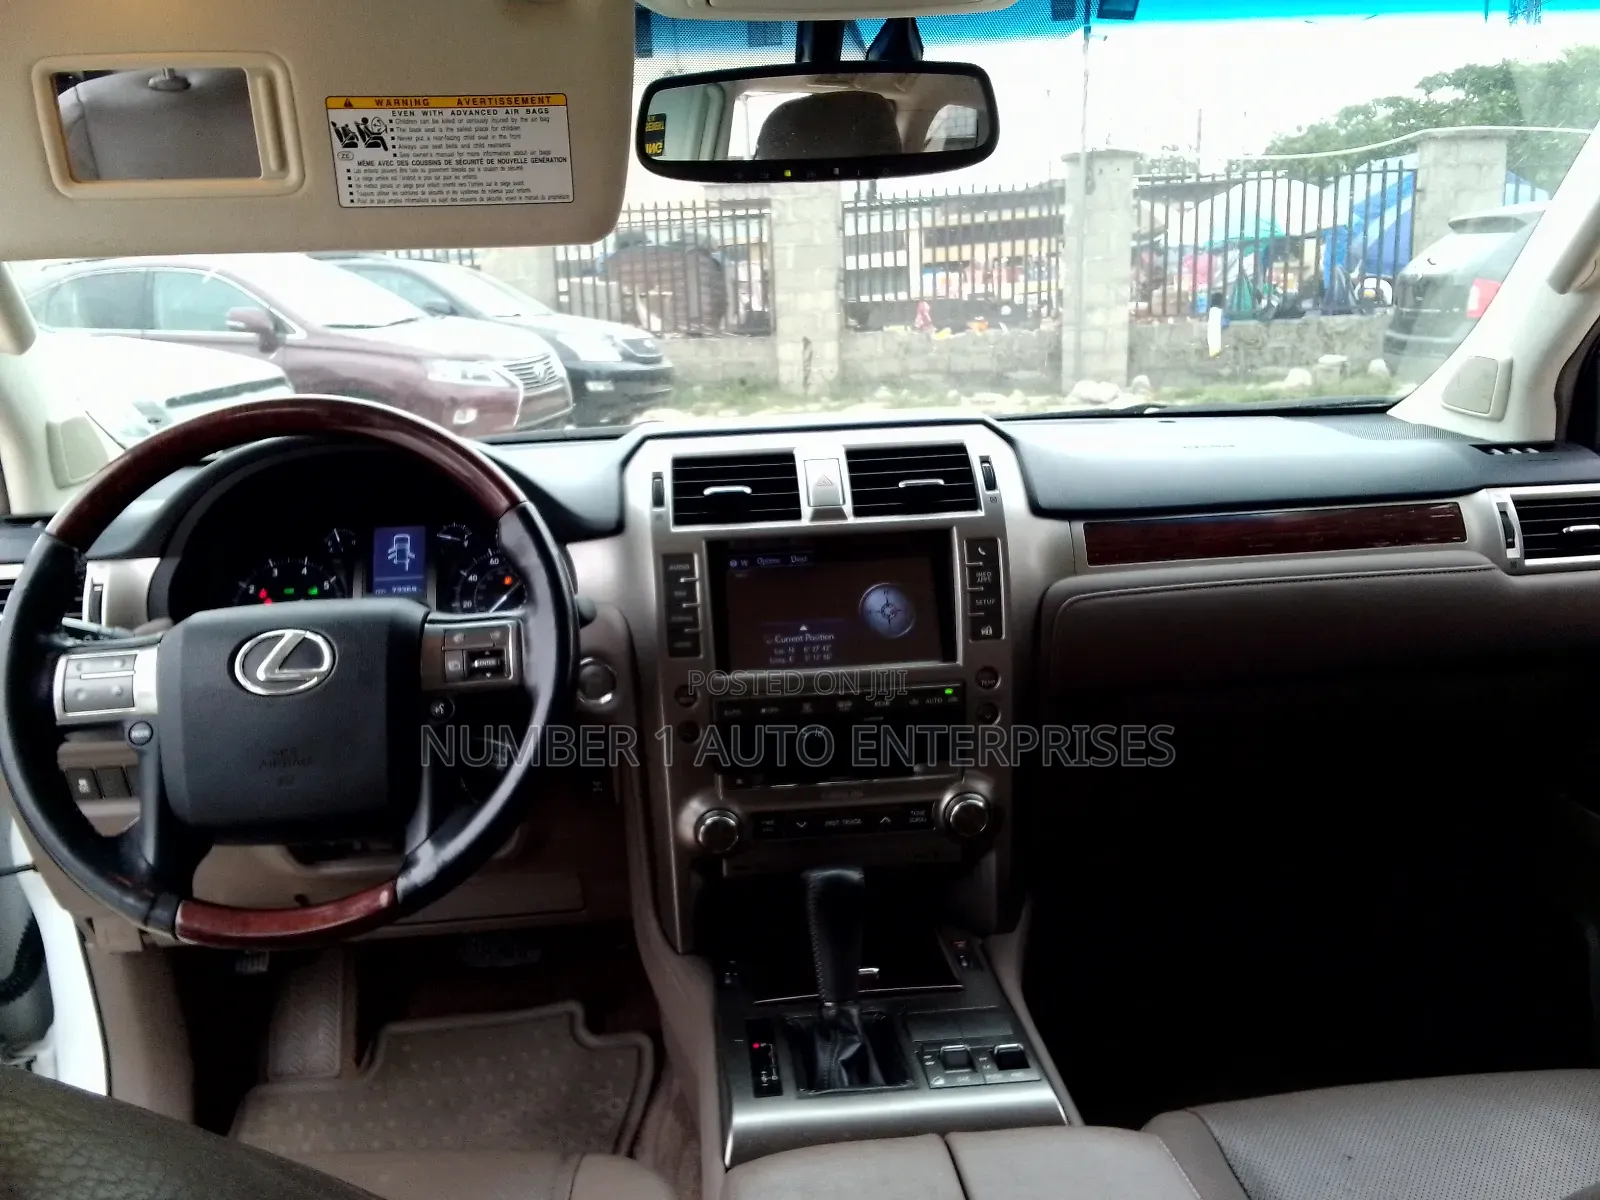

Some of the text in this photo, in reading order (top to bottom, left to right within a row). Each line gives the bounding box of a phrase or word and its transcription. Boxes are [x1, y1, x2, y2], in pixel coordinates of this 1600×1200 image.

[374, 96, 551, 107] WARNING AVERTISSEMENT
[301, 566, 307, 576] 4
[468, 574, 478, 582] 40
[774, 633, 834, 644] Current Position
